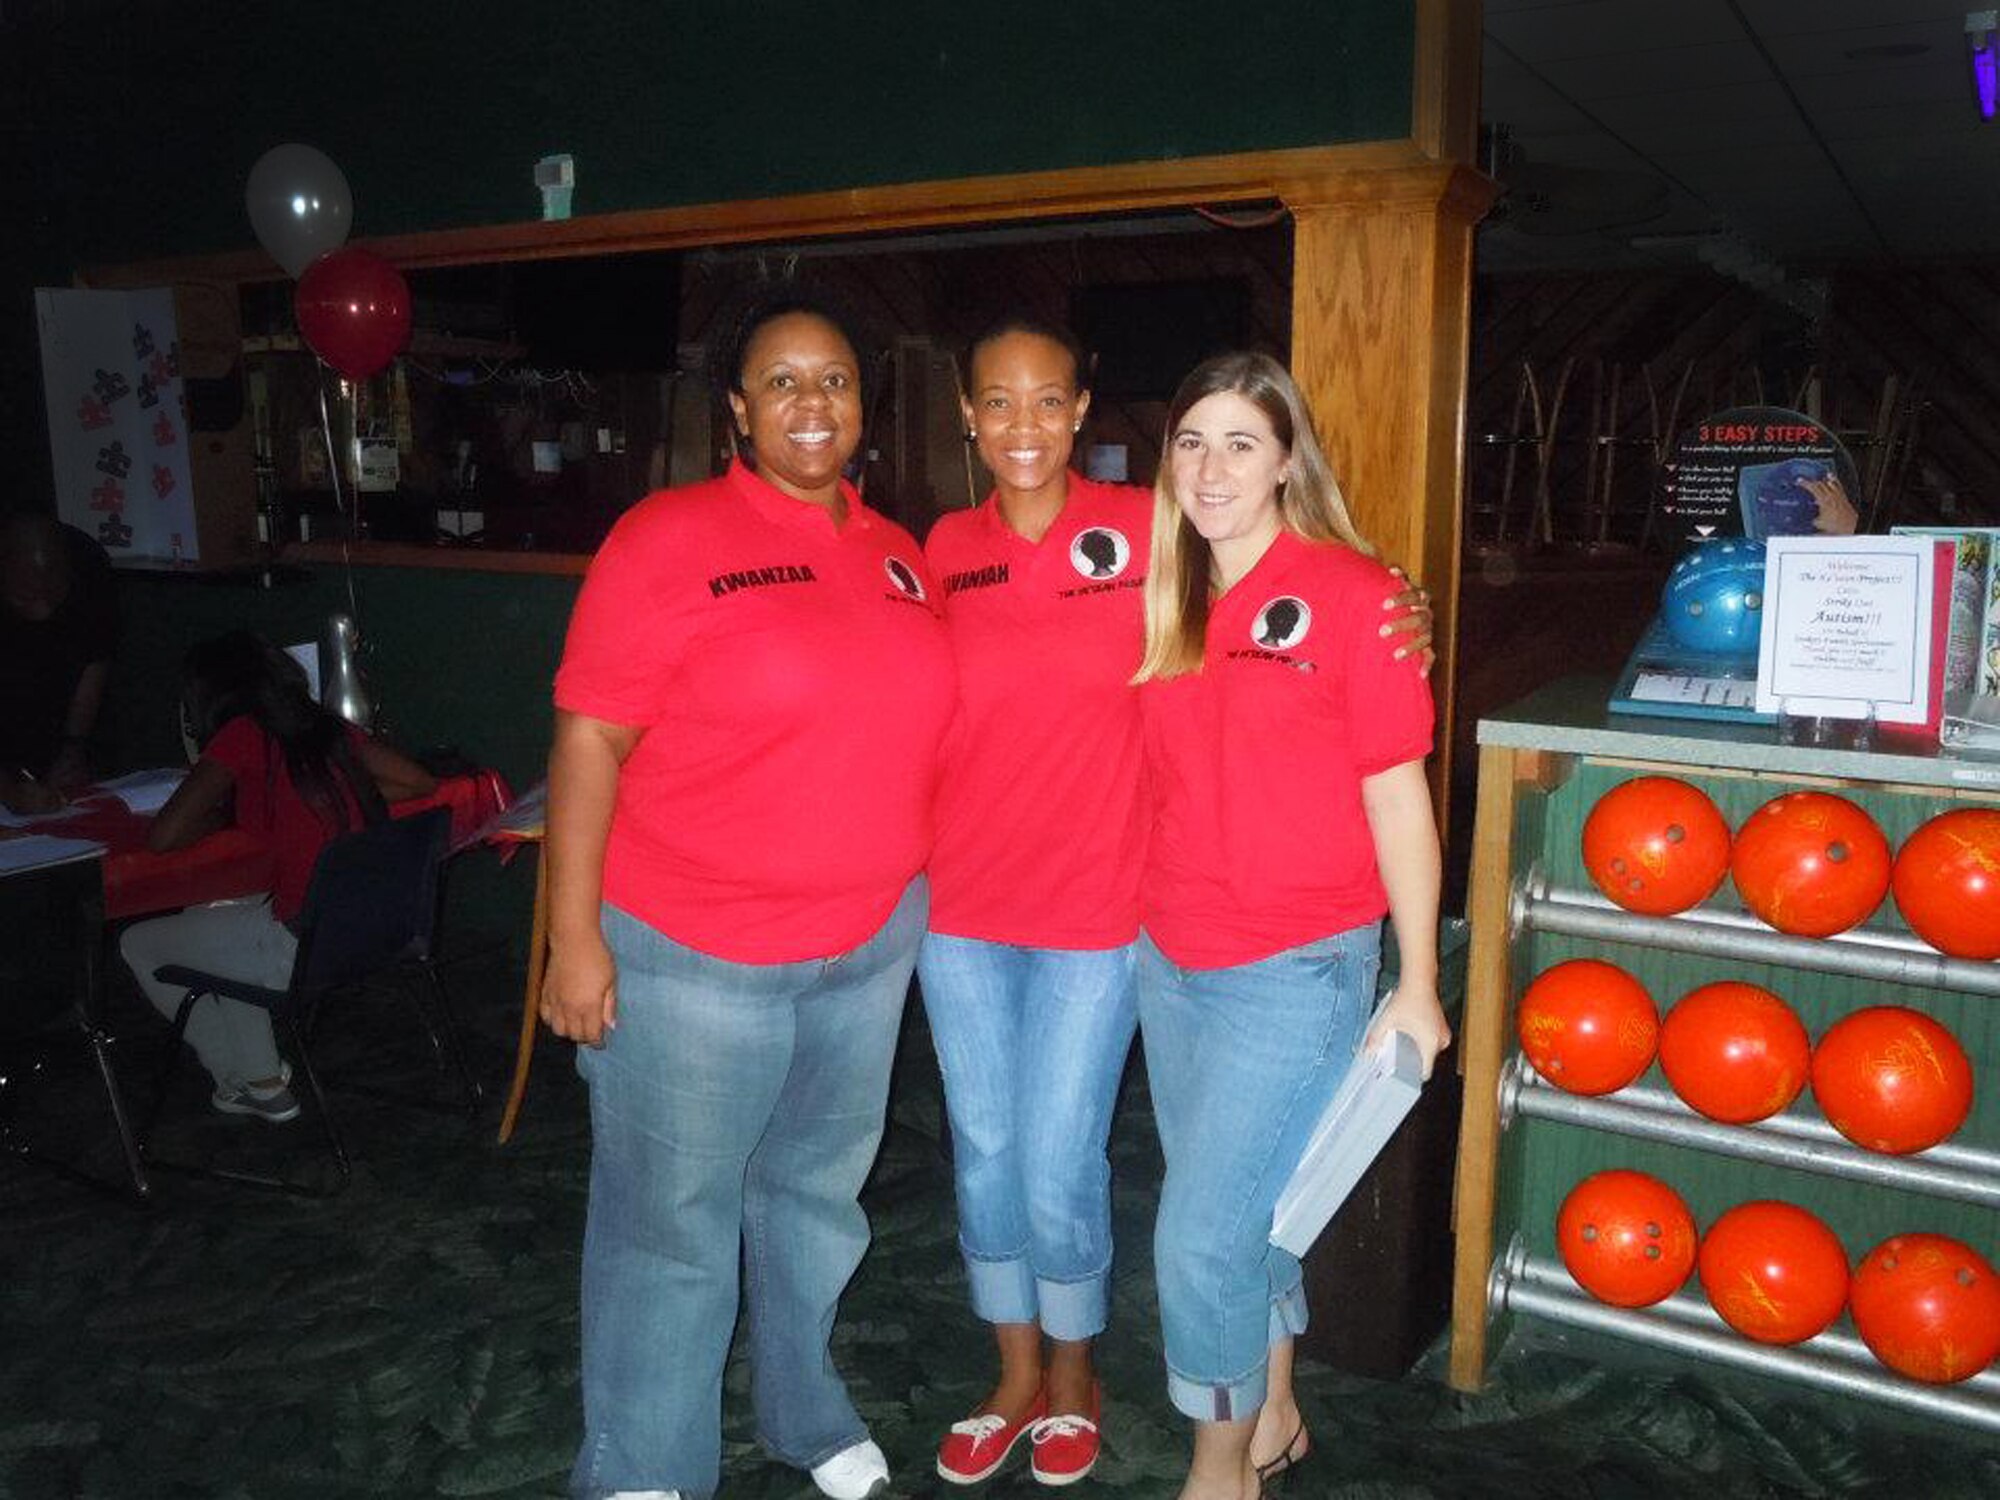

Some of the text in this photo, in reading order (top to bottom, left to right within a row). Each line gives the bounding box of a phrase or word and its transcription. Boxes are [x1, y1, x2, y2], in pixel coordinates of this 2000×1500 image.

[1699, 425, 1819, 442] 3 EASY STEPS
[708, 565, 817, 598] KWANZAA
